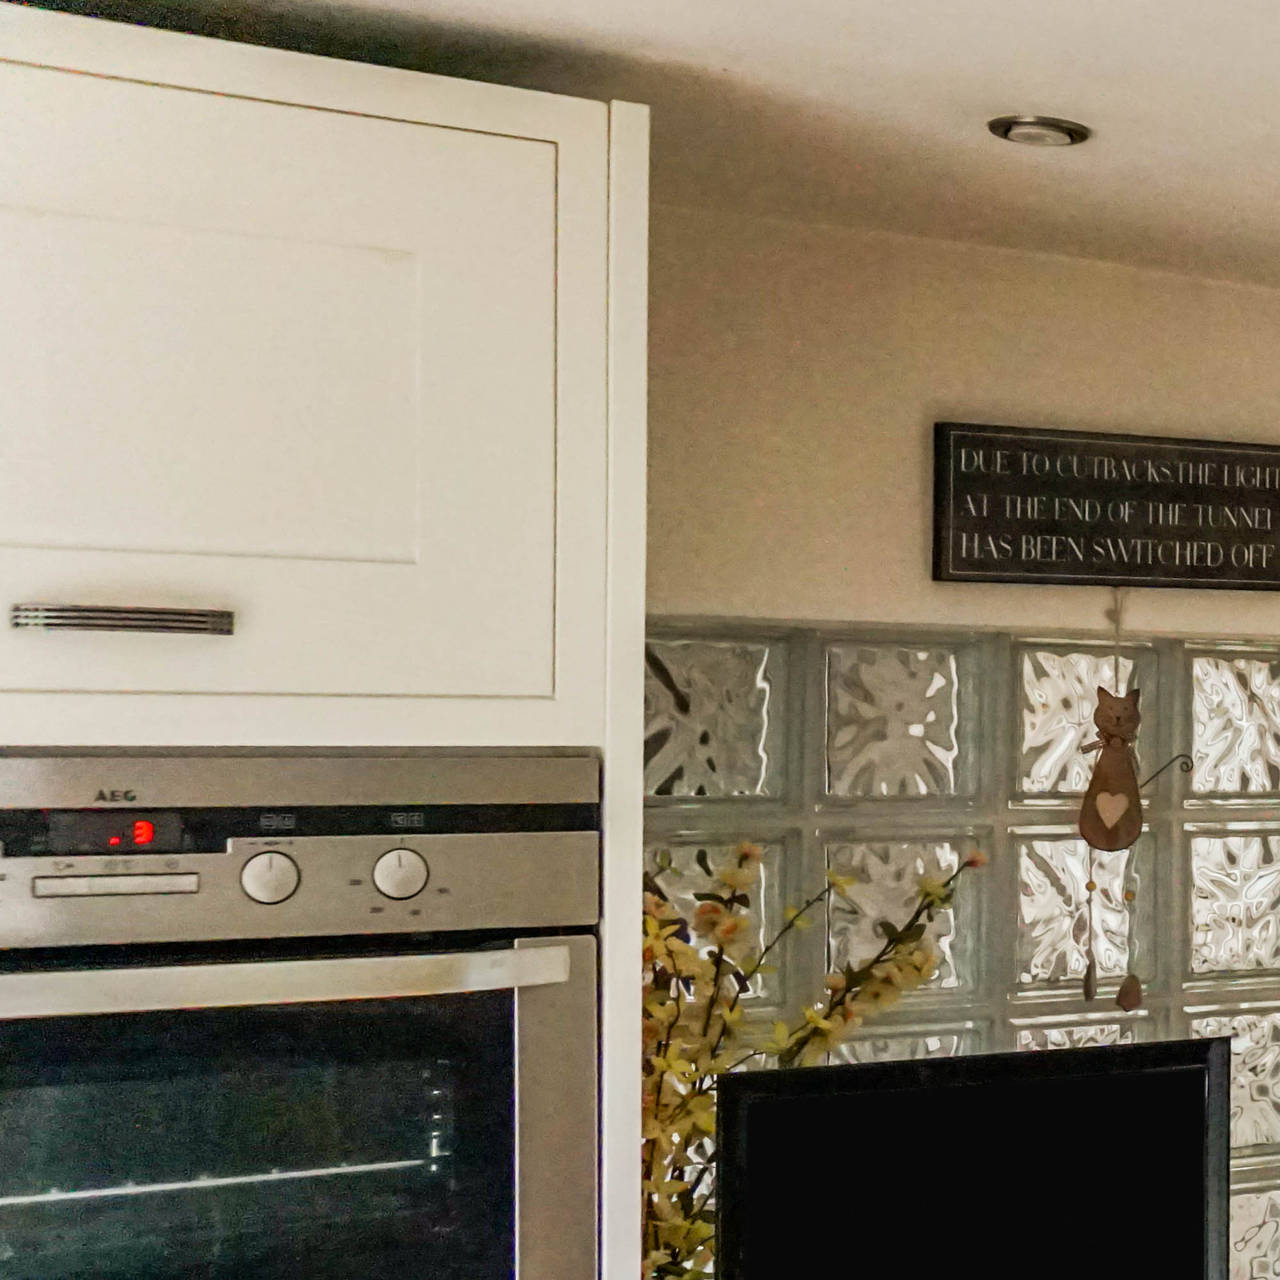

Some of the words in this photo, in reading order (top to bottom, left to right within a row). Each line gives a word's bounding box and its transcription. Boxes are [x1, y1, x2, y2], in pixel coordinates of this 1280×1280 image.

[961, 448, 1009, 474] DUE
[1018, 450, 1049, 477] TO
[1175, 461, 1217, 486] THE
[960, 493, 992, 518] AT
[1001, 494, 1047, 520] THE
[1054, 496, 1101, 522] END
[1107, 500, 1137, 524] OF
[1148, 501, 1187, 526] THE
[1192, 503, 1273, 530] TUNNEL
[961, 532, 1013, 560] HAS
[1021, 534, 1084, 562] BEEN
[1092, 537, 1224, 568] SWITCHED
[1231, 542, 1276, 569] OFF
[94, 789, 137, 802] AEG
